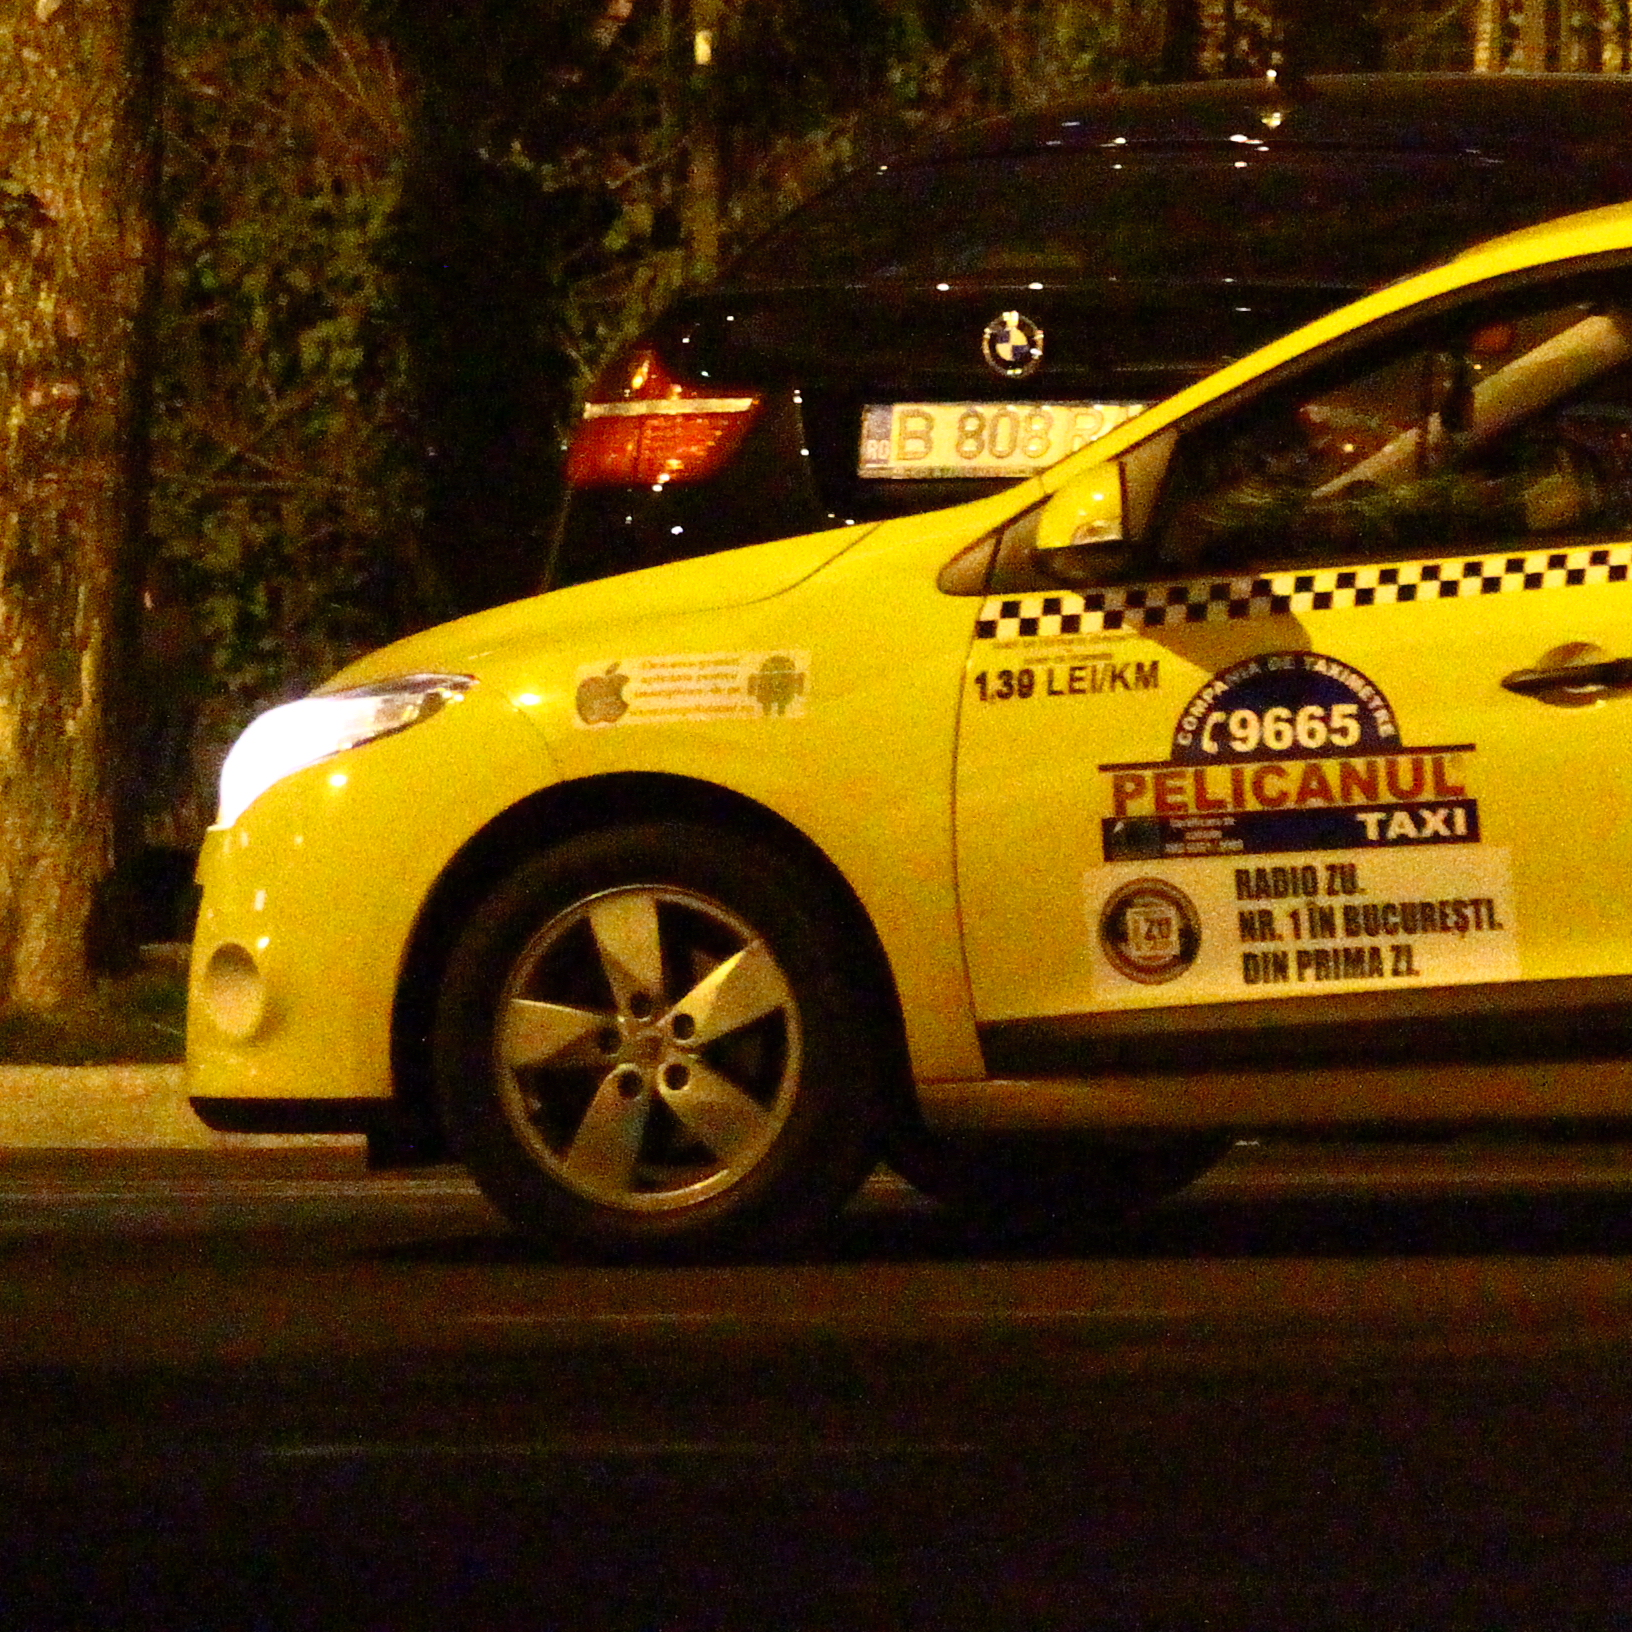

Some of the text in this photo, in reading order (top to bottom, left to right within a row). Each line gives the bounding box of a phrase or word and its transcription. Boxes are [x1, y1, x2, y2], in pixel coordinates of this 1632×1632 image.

[897, 408, 934, 460] B
[955, 407, 1053, 460] 808
[1047, 659, 1160, 696] LEI/KM
[1228, 703, 1361, 753] 9665
[1111, 754, 1466, 820] PELICANUL
[1356, 806, 1469, 842] TAXI
[1234, 864, 1319, 901] RADIO
[1236, 908, 1284, 943] NR.
[1288, 908, 1302, 940] 1
[1241, 950, 1290, 985] DIN
[1295, 945, 1384, 982] PRIMA
